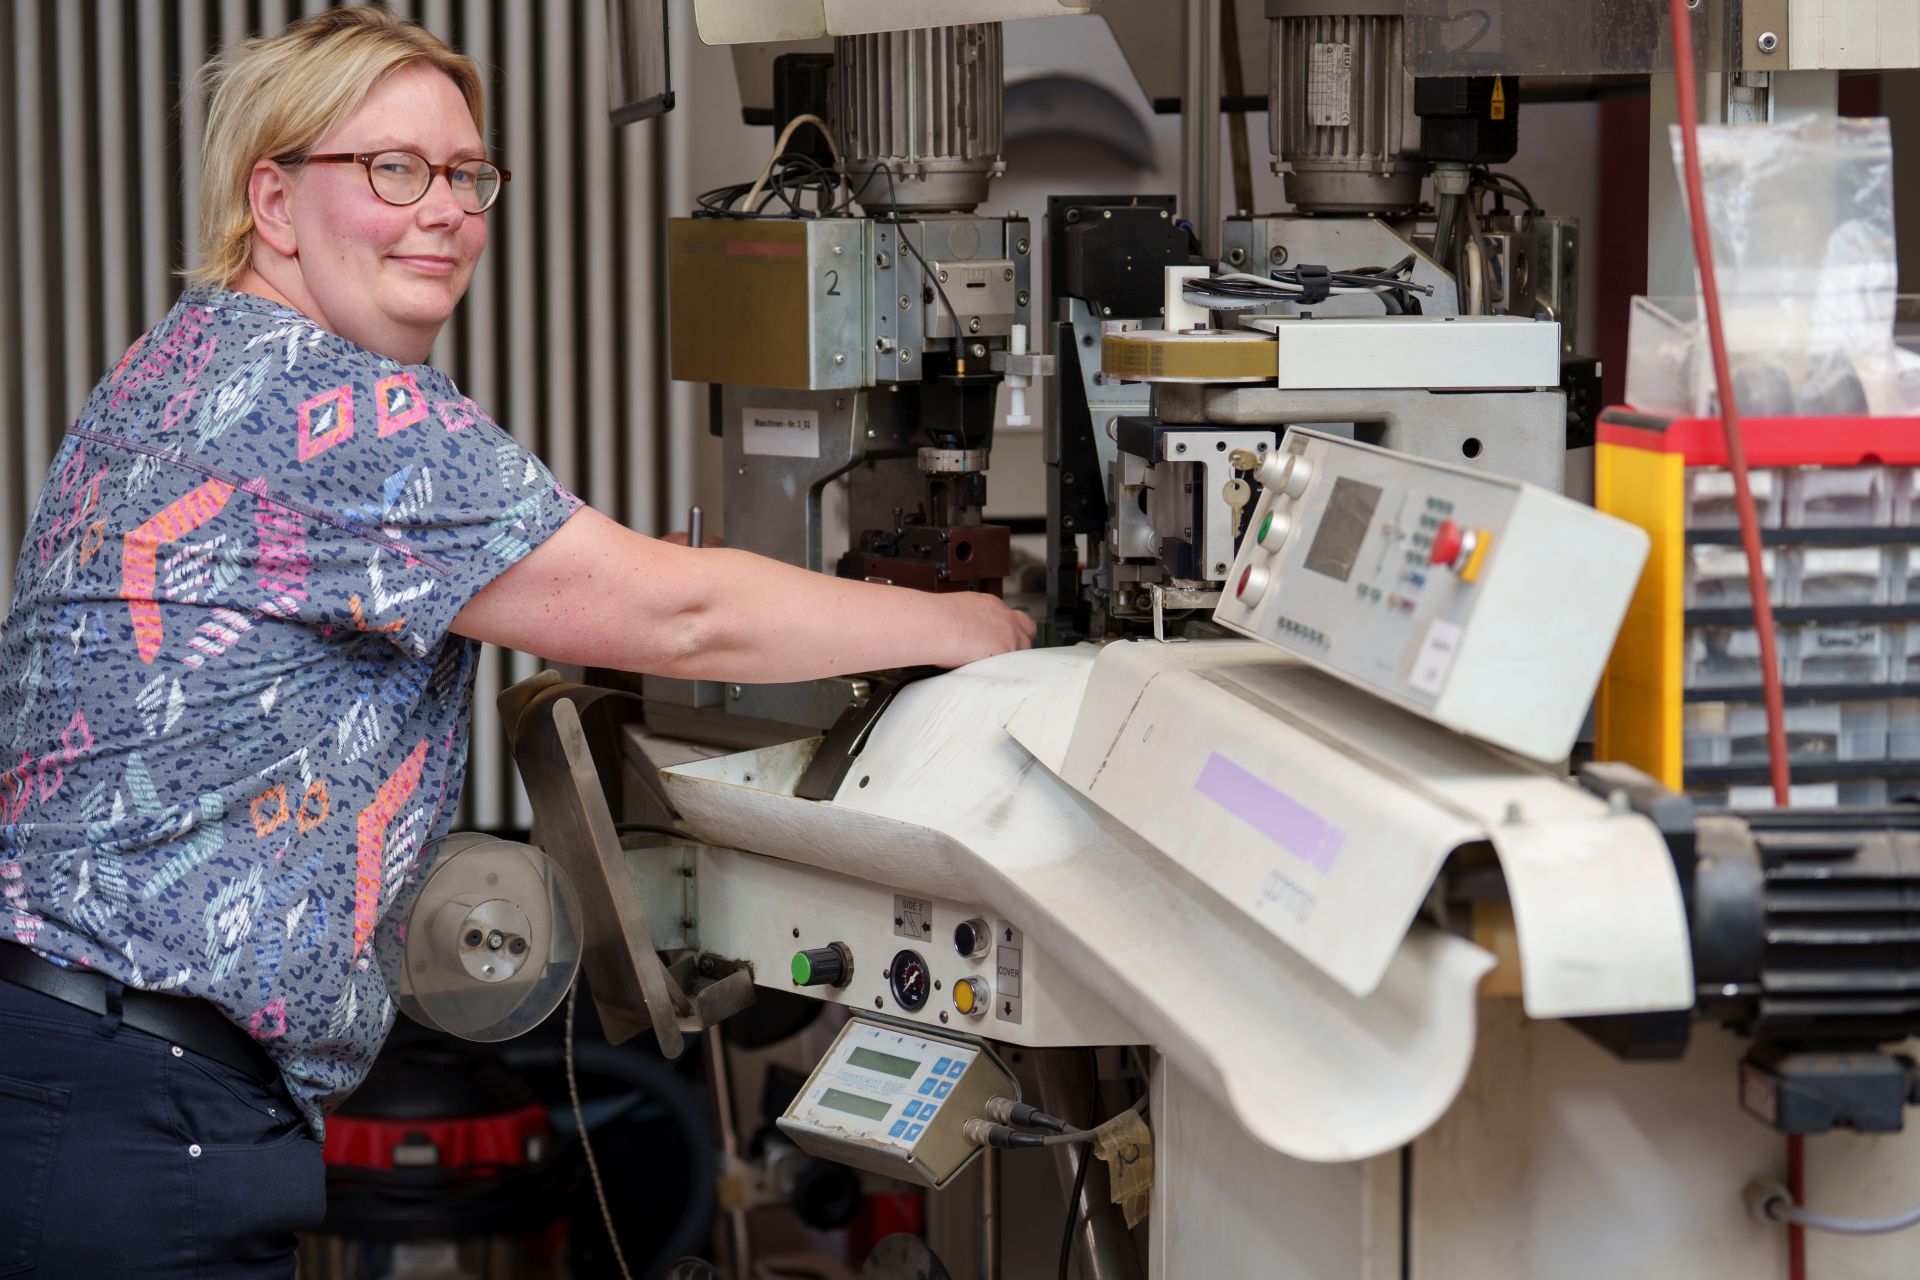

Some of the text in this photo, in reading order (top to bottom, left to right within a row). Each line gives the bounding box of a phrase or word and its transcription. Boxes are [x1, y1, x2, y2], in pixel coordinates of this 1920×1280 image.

[824, 269, 841, 296] 2
[902, 900, 923, 912] SIDE 2
[999, 966, 1019, 978] COVER
